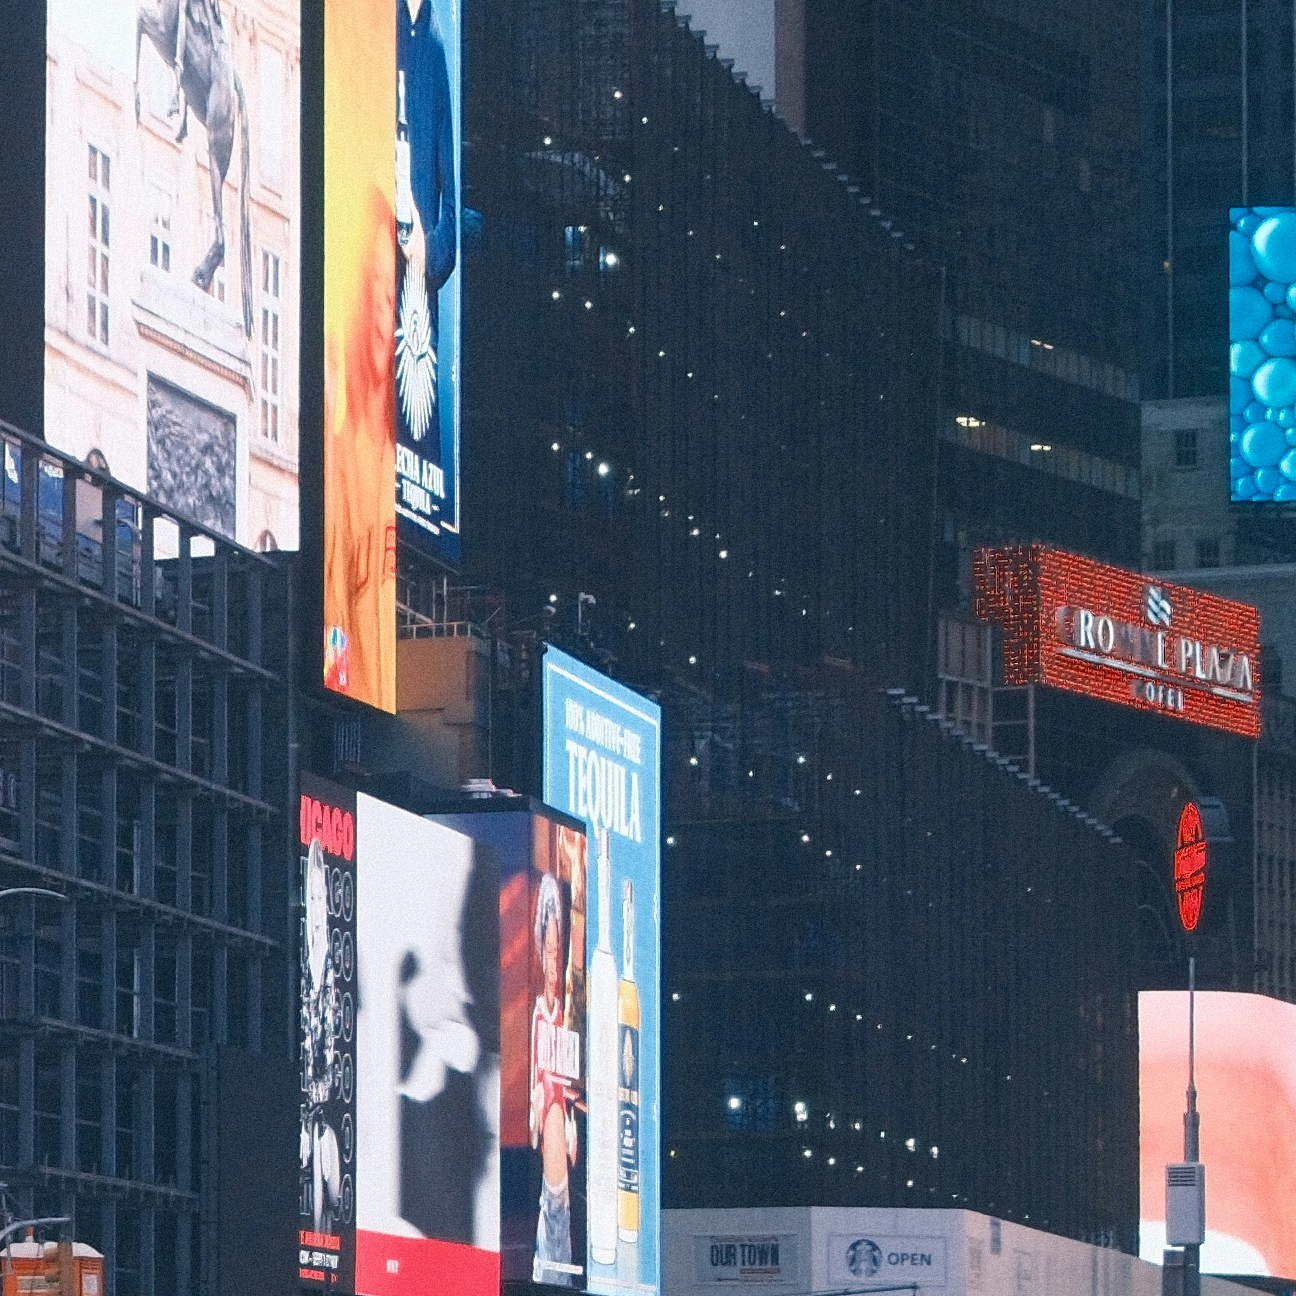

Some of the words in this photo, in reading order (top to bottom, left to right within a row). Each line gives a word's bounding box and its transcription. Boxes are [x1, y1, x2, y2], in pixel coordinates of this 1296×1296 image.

[565, 738, 643, 844] TEQUILA
[710, 1243, 737, 1267] OUR
[740, 1242, 779, 1267] TOWN
[887, 1251, 933, 1267] OPEN
